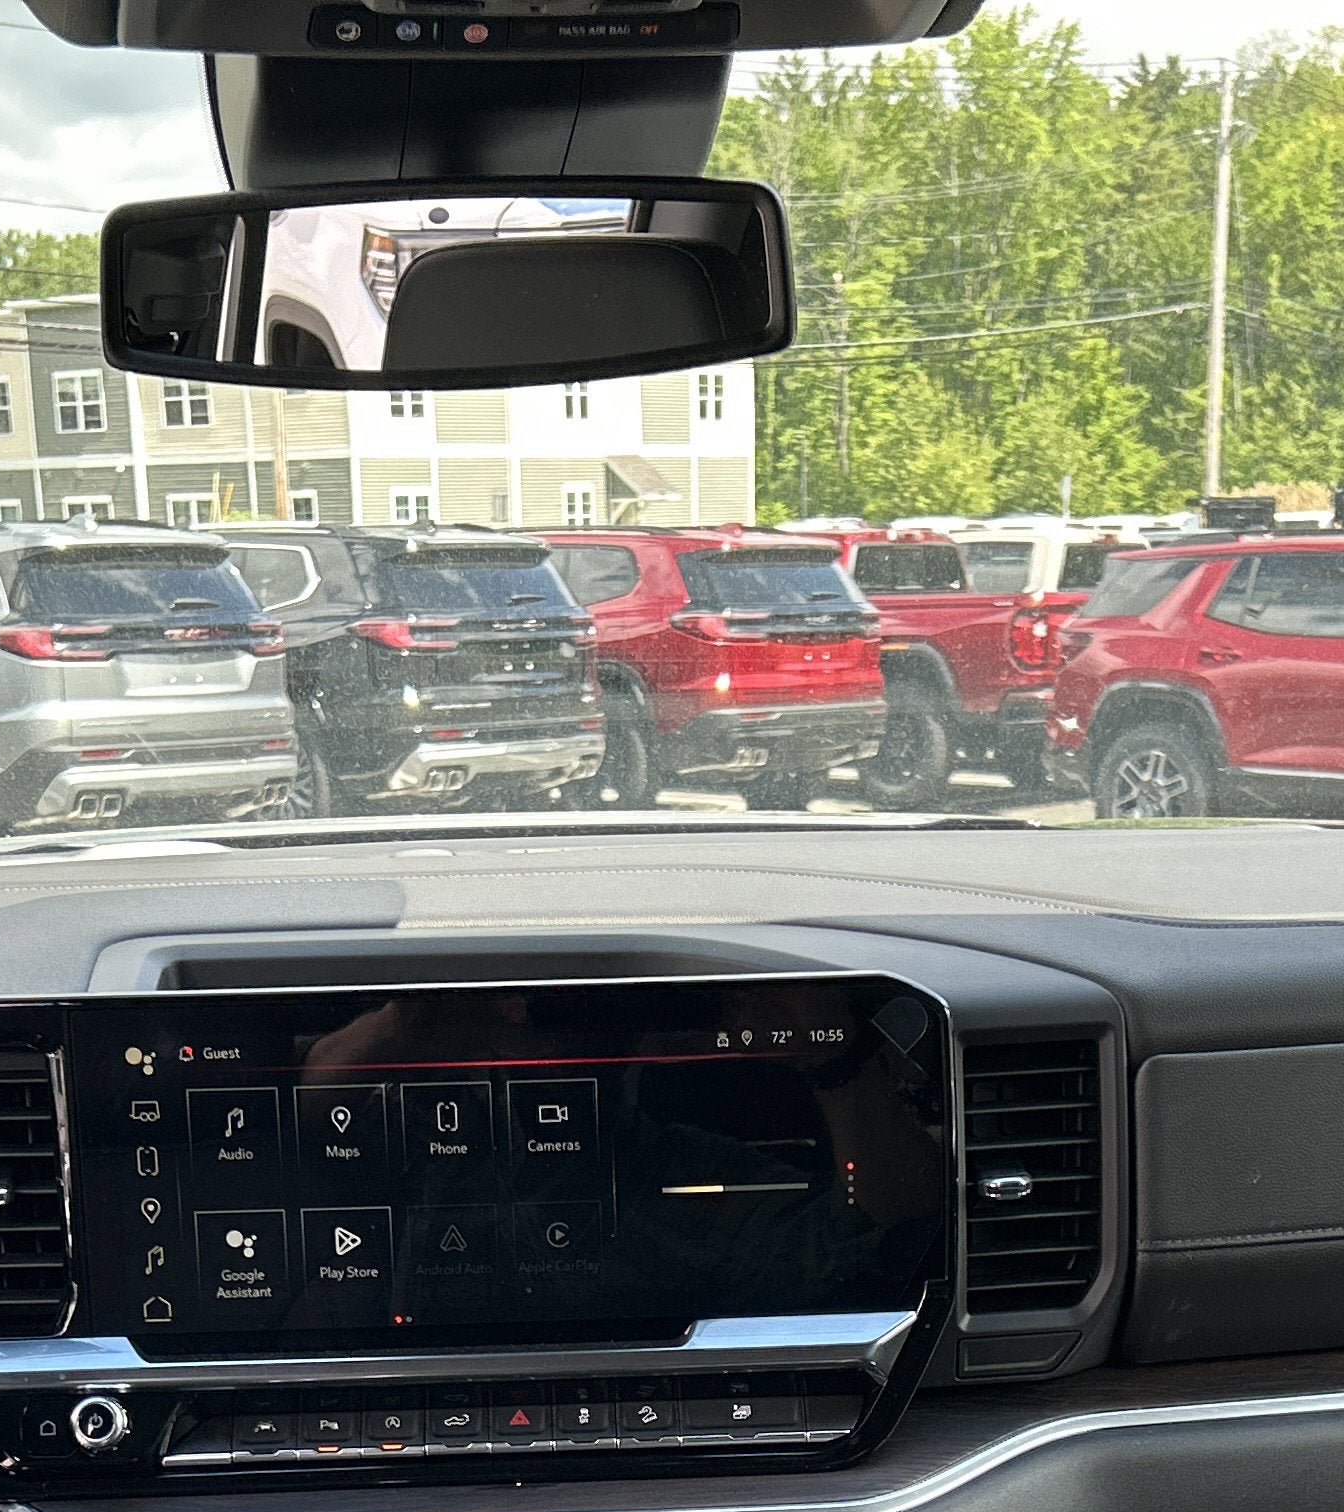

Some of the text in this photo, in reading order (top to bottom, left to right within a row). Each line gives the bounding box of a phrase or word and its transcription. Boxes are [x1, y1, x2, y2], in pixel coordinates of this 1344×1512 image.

[809, 1029, 844, 1042] 10:55
[203, 1047, 241, 1060] Guest
[430, 1142, 468, 1155] Phone
[527, 1139, 581, 1152] Cameras
[218, 1147, 254, 1160] Audio
[326, 1145, 360, 1160] Maps
[221, 1269, 265, 1284] Google
[319, 1266, 379, 1281] Play Store
[216, 1286, 272, 1299] Assistant
